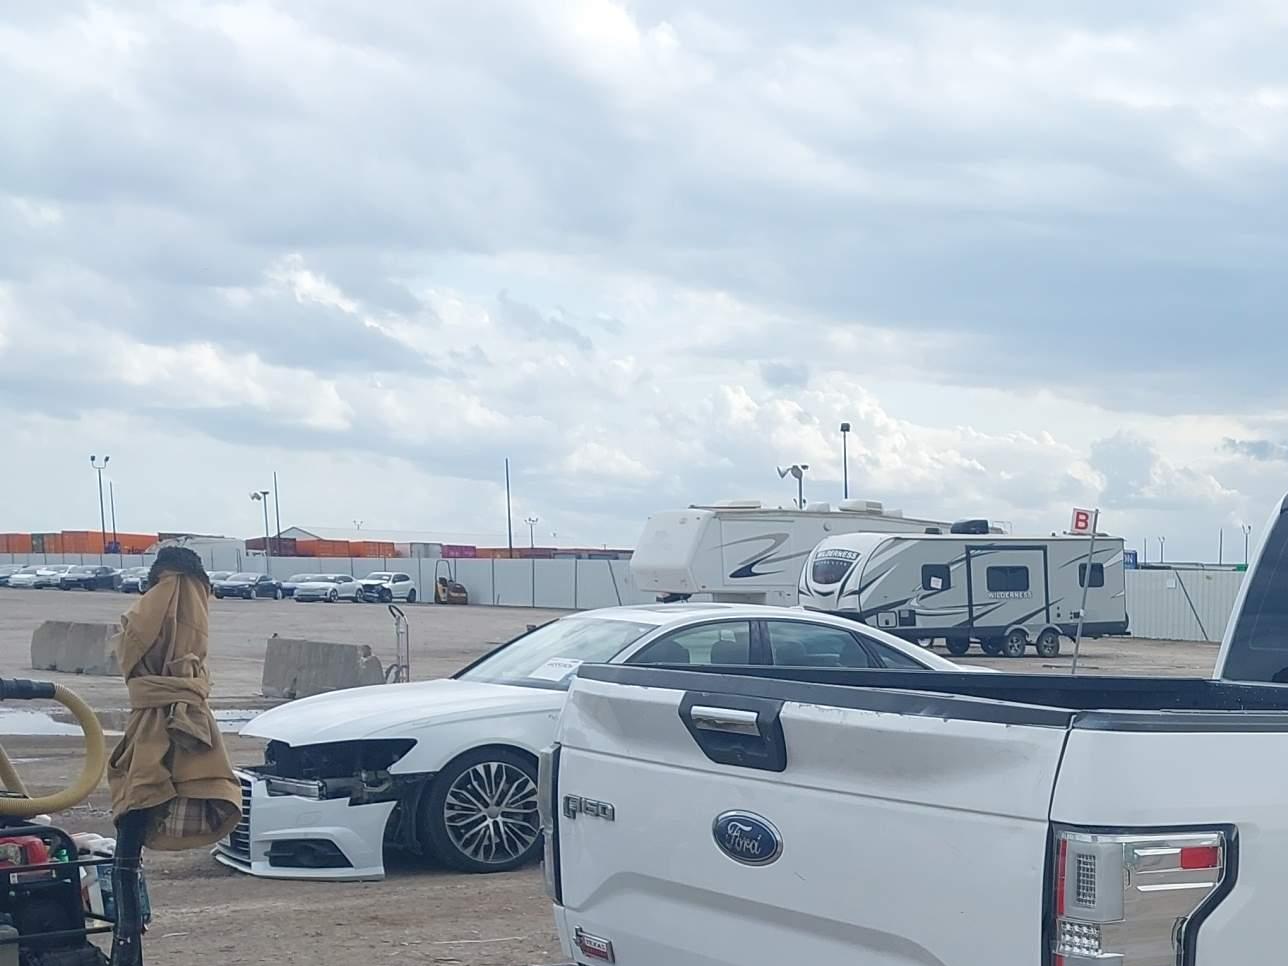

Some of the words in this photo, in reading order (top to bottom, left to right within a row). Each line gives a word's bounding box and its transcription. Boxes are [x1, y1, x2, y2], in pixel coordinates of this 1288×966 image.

[1075, 511, 1089, 530] B
[817, 549, 858, 560] WILDERNESS
[585, 939, 606, 950] TEXAS
